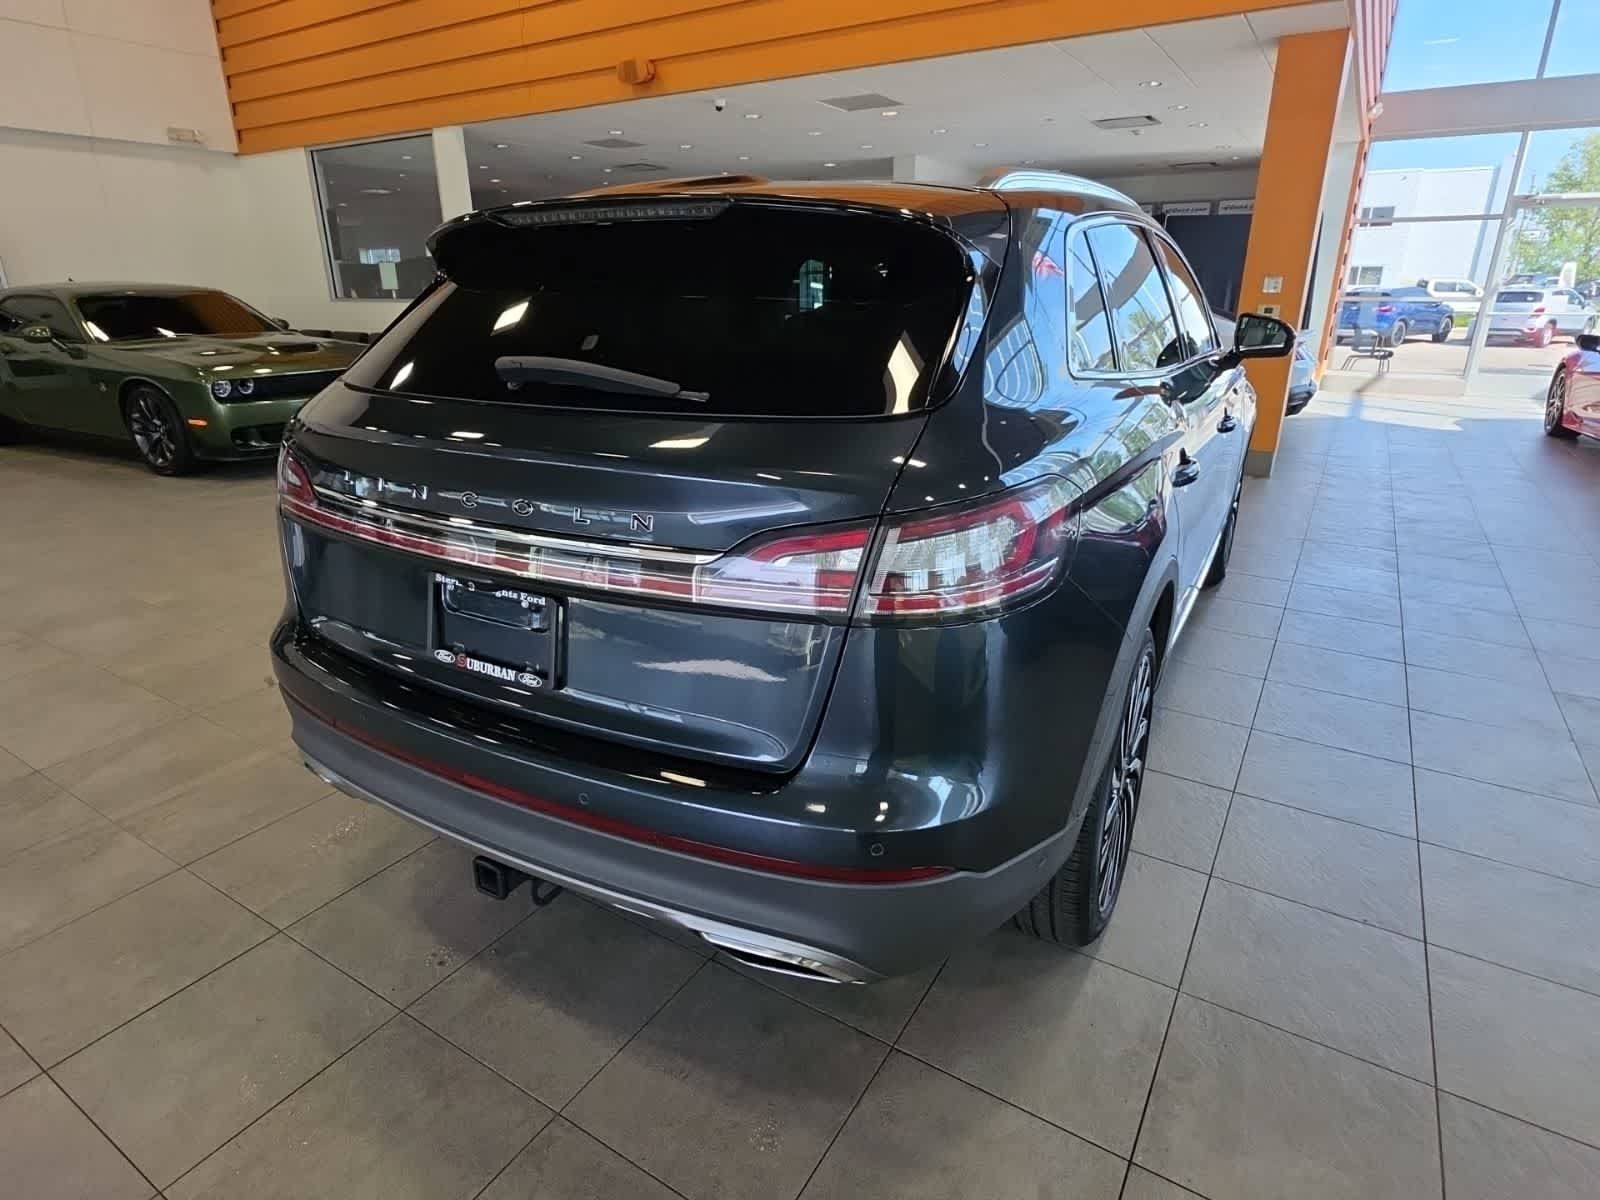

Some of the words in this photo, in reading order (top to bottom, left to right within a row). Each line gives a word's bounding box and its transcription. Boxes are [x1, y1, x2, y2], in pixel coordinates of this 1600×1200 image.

[343, 470, 654, 532] LINCOLN
[520, 592, 546, 606] Ford
[457, 653, 516, 681] SUBURBAN
